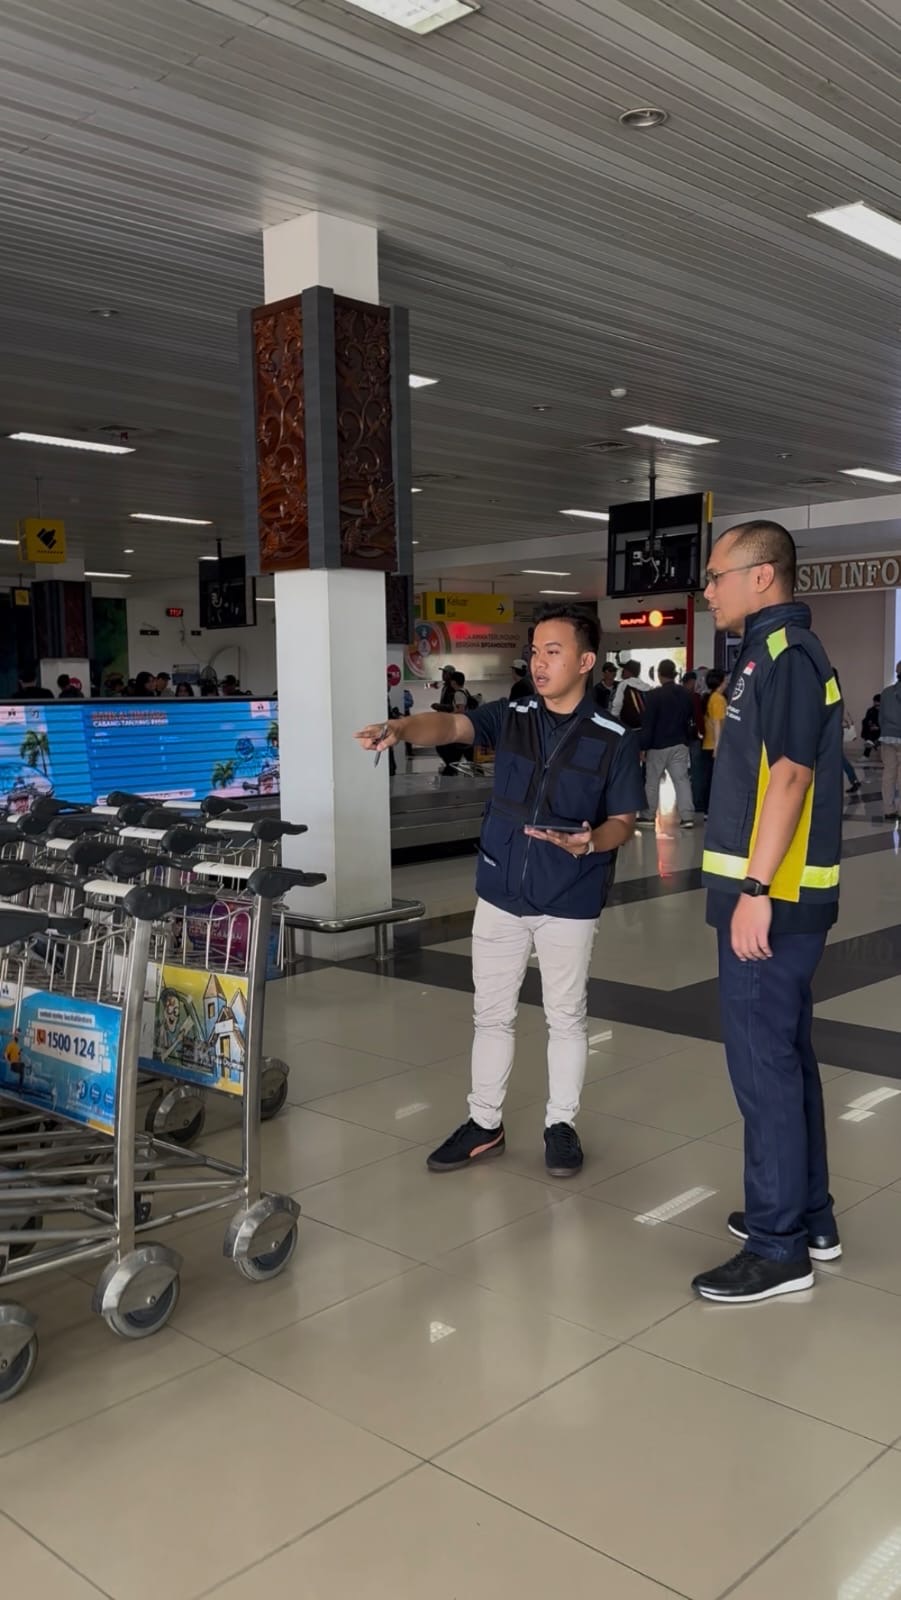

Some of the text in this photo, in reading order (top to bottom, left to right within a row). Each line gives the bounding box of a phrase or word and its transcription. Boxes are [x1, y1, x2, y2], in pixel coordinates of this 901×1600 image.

[795, 559, 900, 592] SM INFO
[47, 1031, 96, 1060] 1500 124
